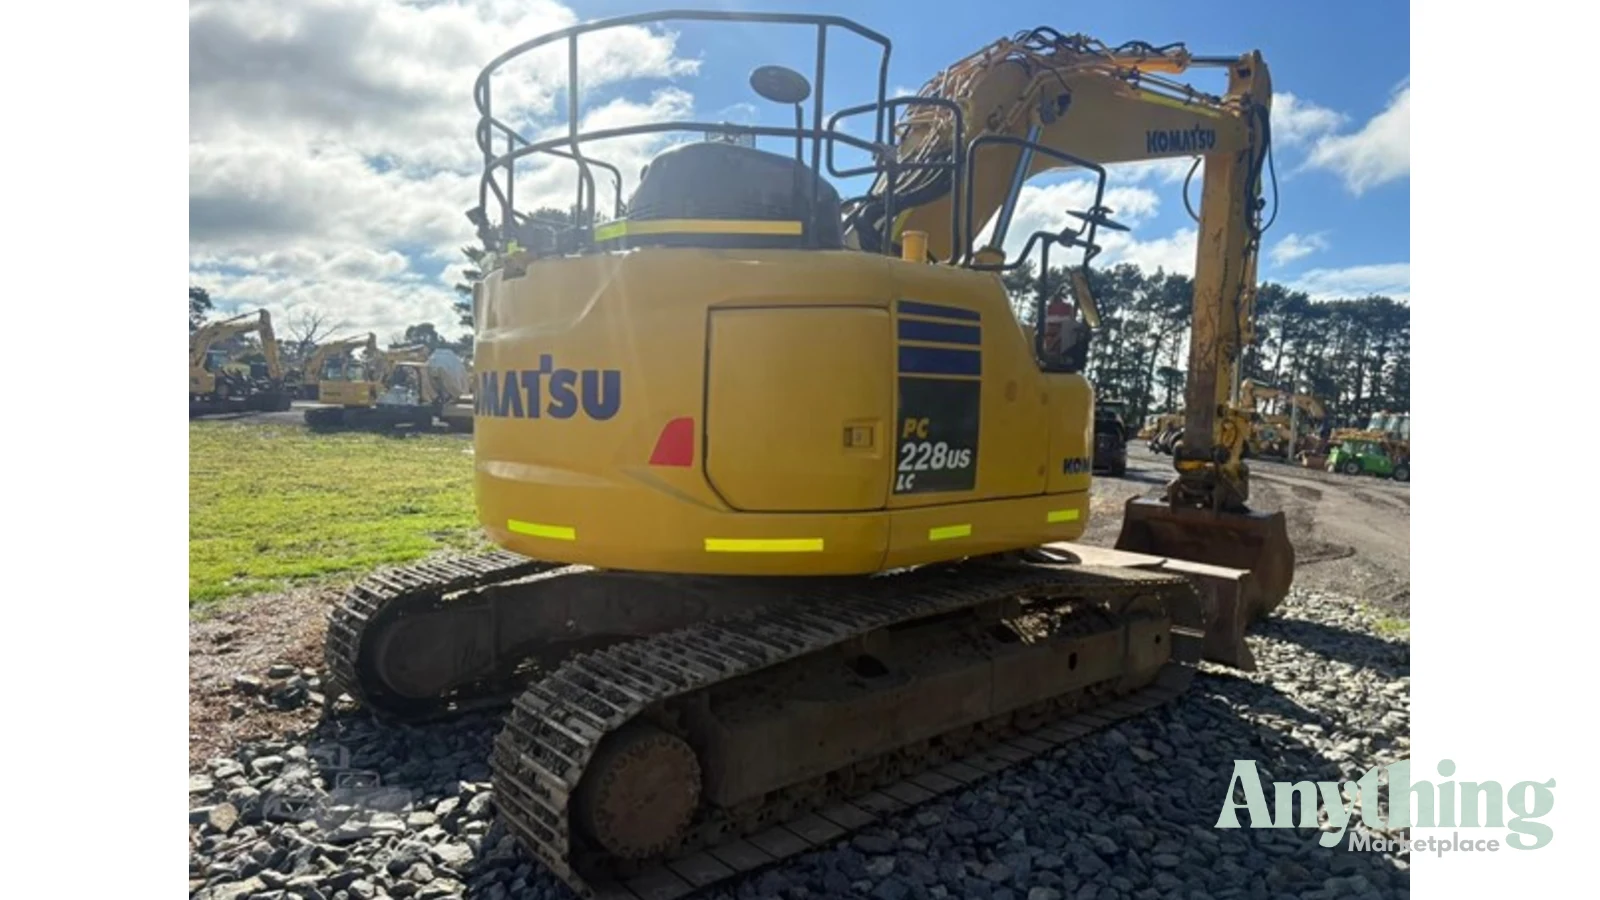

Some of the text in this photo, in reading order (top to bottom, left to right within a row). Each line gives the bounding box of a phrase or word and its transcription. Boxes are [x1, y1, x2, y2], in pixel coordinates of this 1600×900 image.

[1146, 123, 1216, 153] KOMATSU
[902, 417, 930, 439] PC
[896, 473, 916, 491] LC
